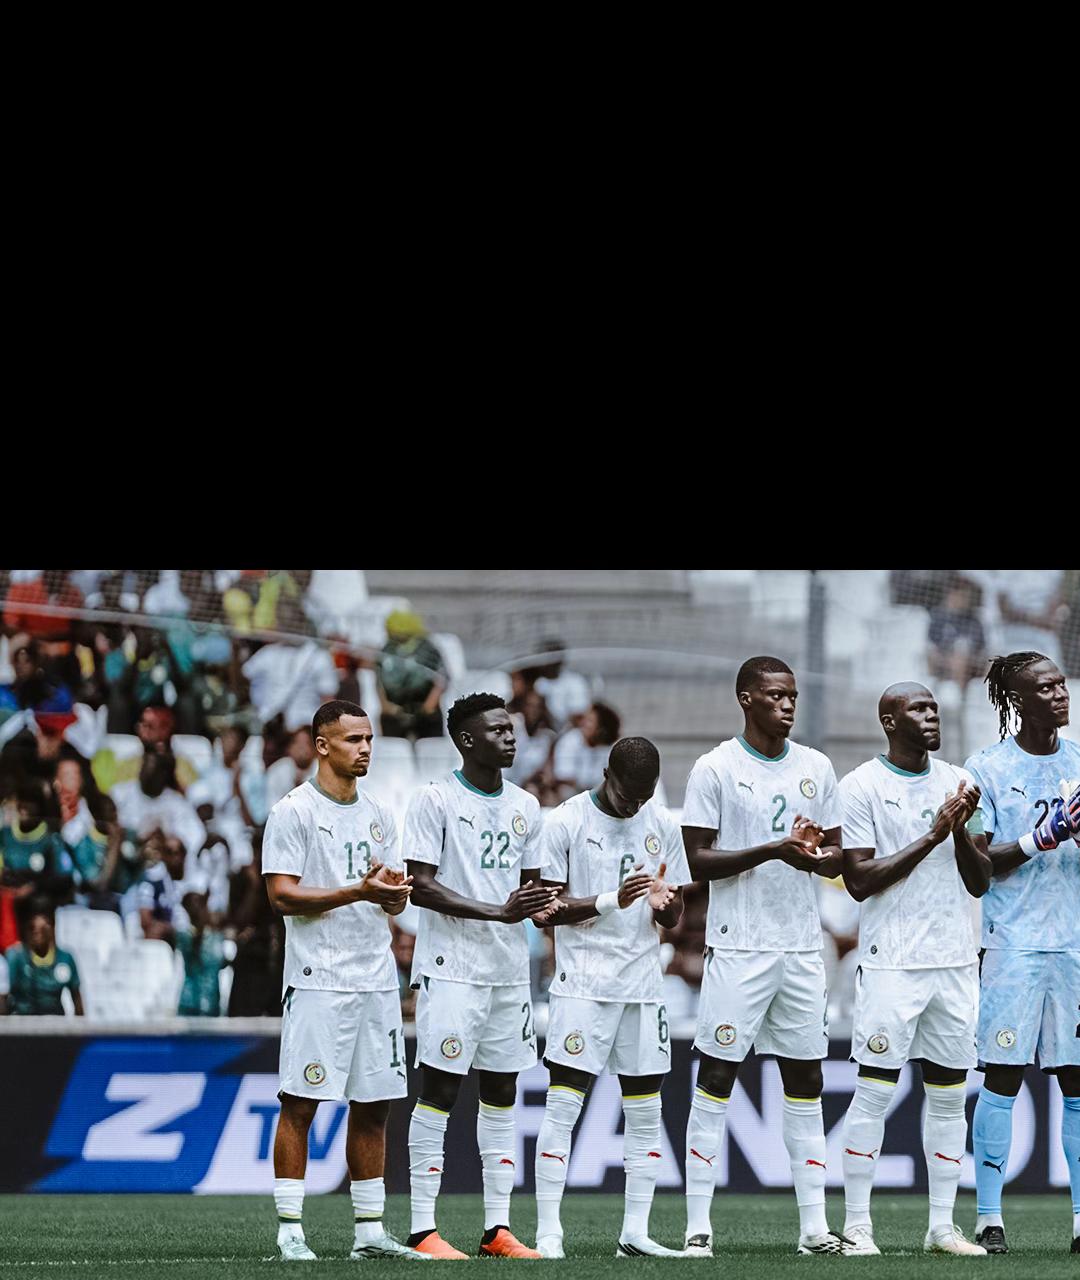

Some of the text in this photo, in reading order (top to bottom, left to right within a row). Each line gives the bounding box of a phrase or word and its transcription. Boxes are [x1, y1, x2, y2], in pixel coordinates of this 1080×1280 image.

[772, 795, 787, 832] 2
[1035, 798, 1063, 829] 2
[344, 841, 371, 879] 13
[480, 830, 511, 869] 22
[521, 1002, 535, 1041] 2
[658, 1005, 669, 1044] 6
[389, 1029, 406, 1068] 1
[82, 1072, 206, 1161] Z
